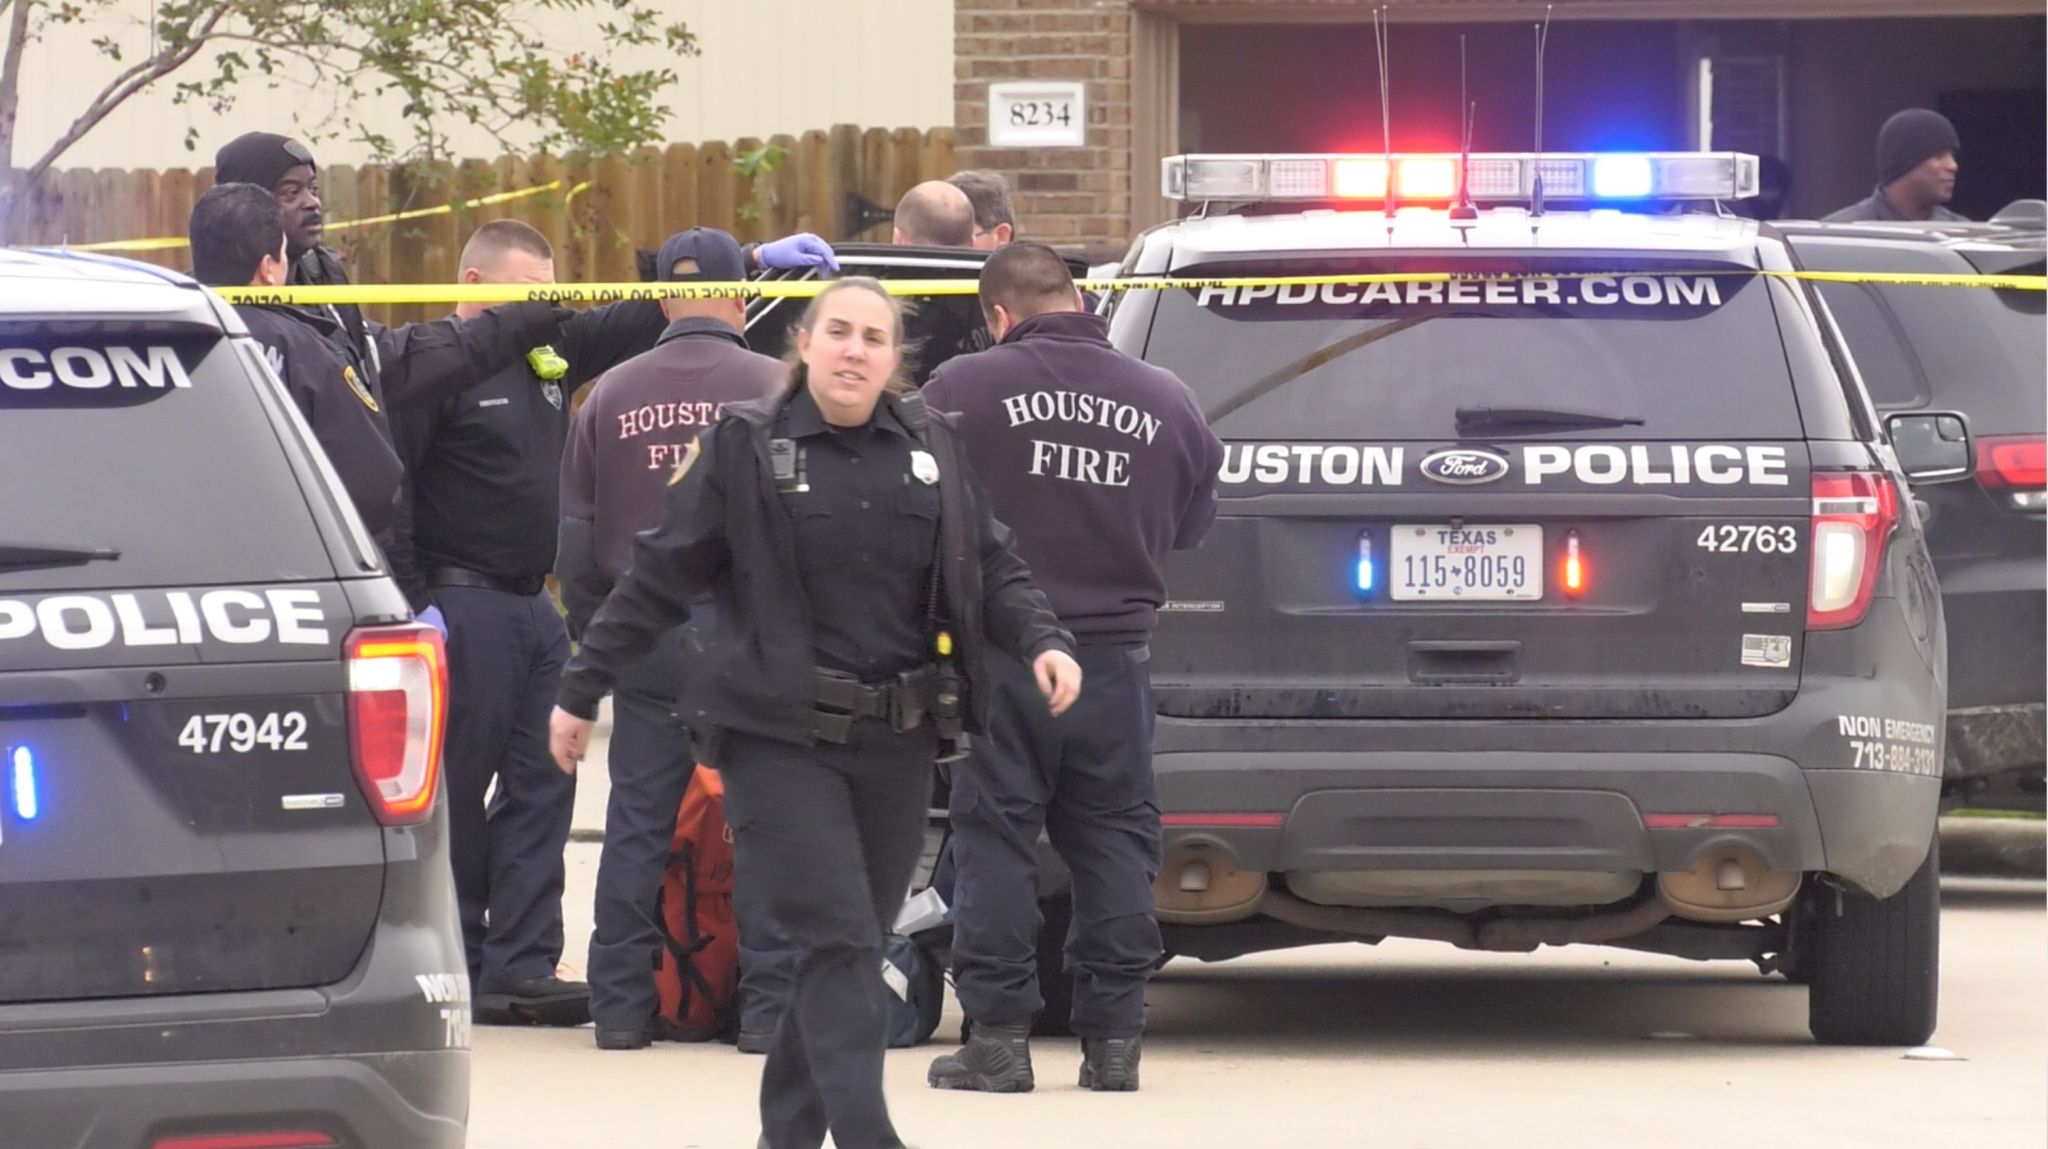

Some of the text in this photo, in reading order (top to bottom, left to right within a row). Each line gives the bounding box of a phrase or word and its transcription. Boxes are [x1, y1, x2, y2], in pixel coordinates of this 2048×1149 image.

[1010, 102, 1070, 127] 8234
[1197, 275, 1722, 306] HPDCAREER.COM
[618, 402, 720, 439] HOUST
[1001, 390, 1162, 446] HOUSTON
[1028, 439, 1131, 487] FIRE
[1440, 454, 1487, 476] Ford
[1523, 445, 1789, 485] POLICE
[1437, 530, 1497, 545] TEXAS
[1447, 545, 1485, 555] EXEMPT
[1697, 525, 1798, 553] 42763
[178, 711, 309, 753] 47942
[1838, 715, 1882, 738] NON
